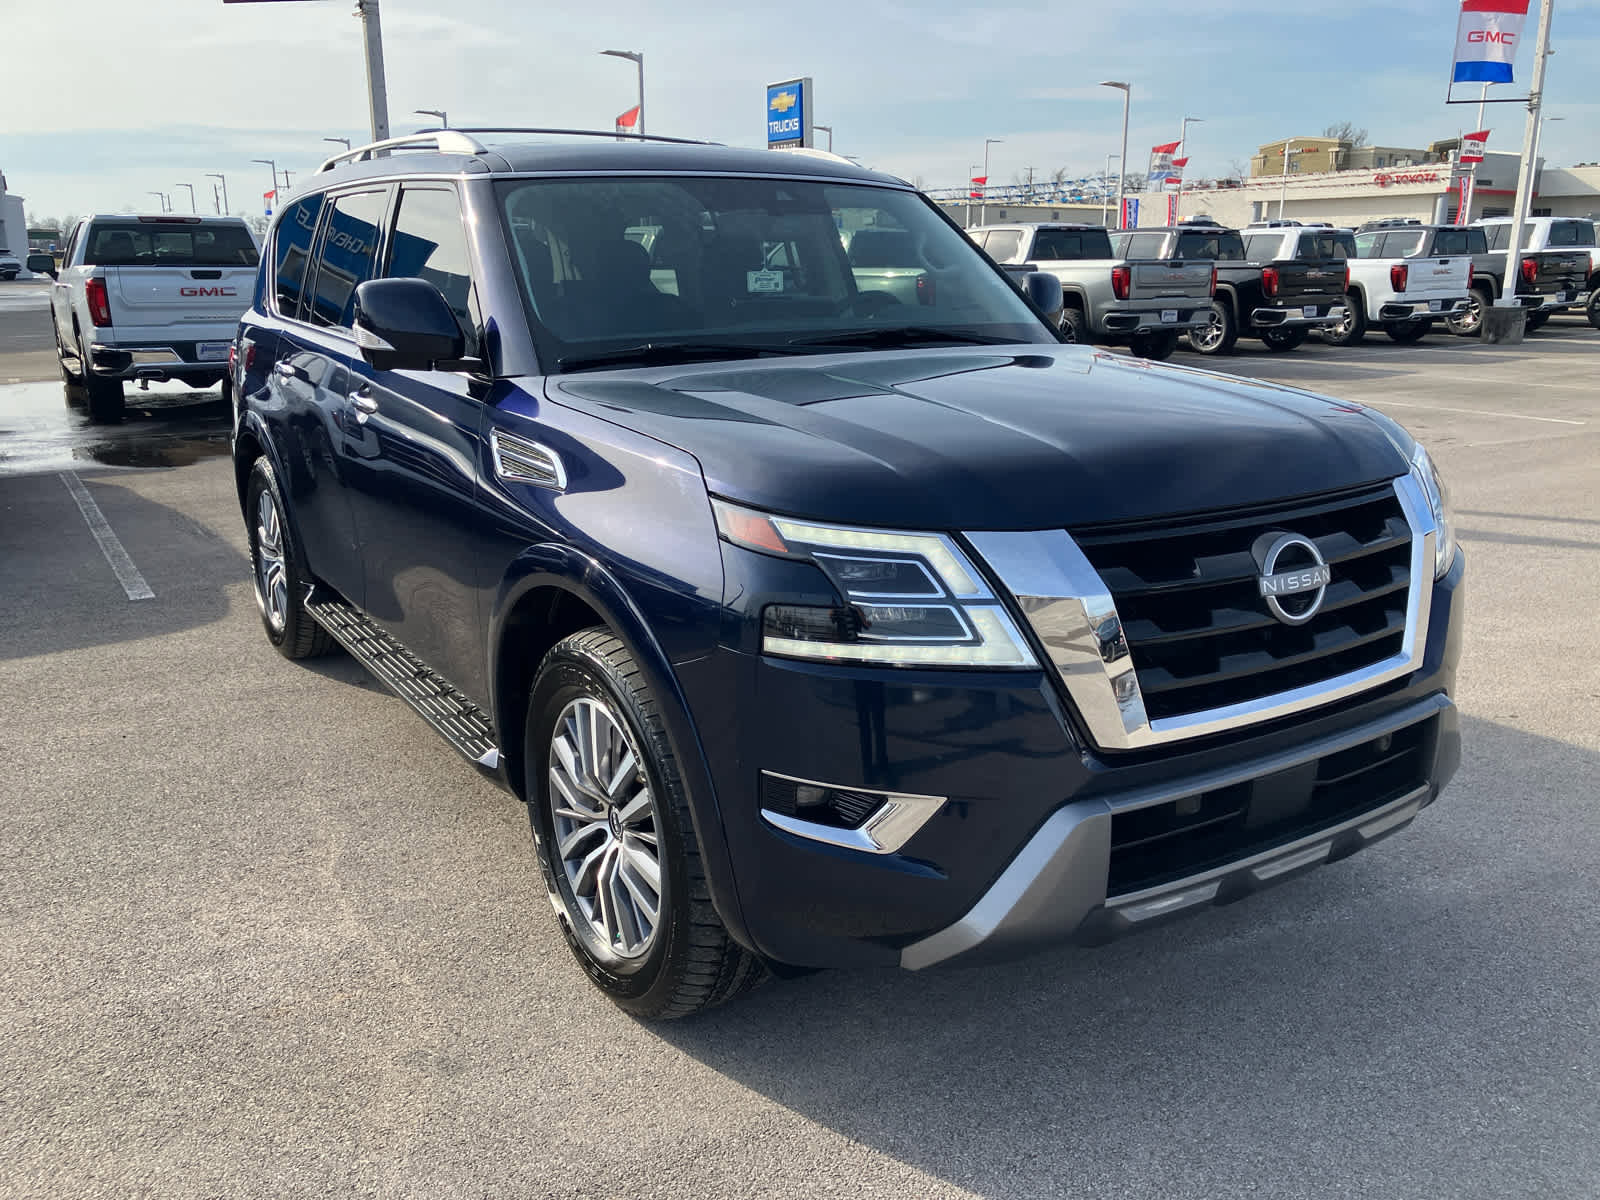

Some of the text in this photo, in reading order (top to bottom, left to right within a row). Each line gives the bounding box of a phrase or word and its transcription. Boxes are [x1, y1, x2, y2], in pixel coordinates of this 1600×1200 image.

[1467, 31, 1516, 45] GMC
[769, 118, 799, 134] TRUCKS
[1395, 173, 1437, 185] TOYOTA
[180, 287, 238, 296] GMC
[1263, 568, 1330, 592] NISSAN
